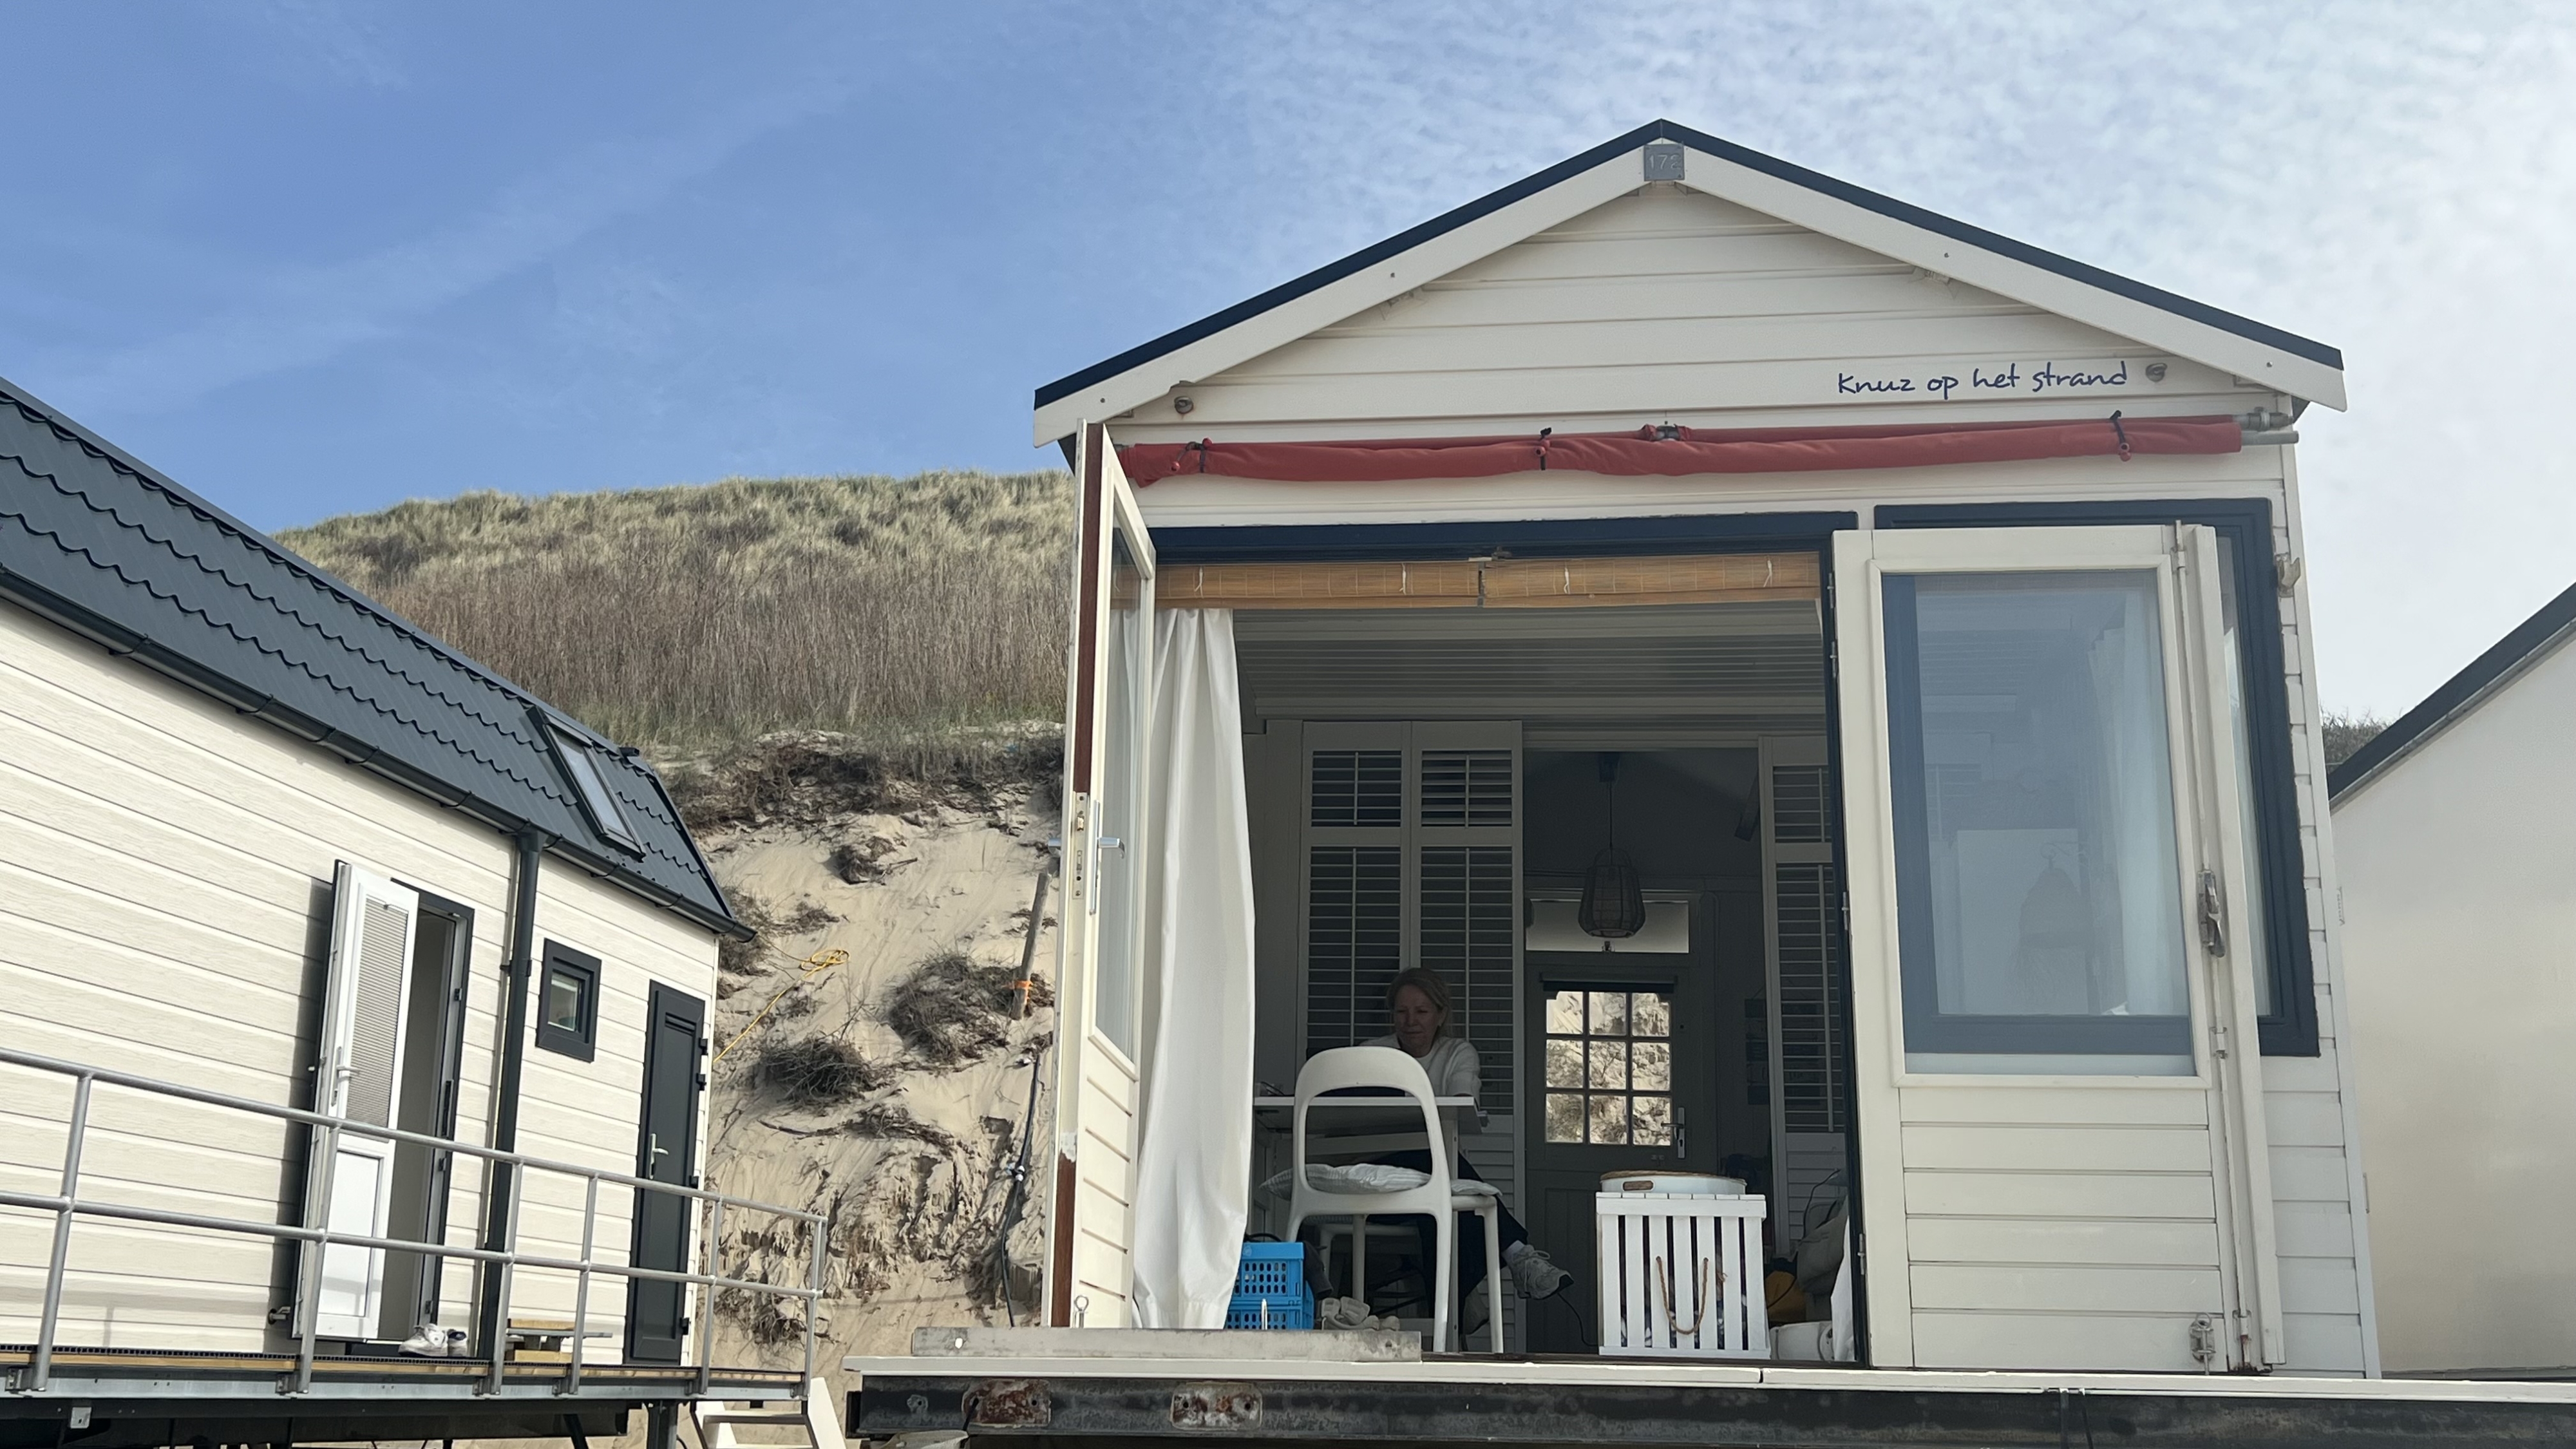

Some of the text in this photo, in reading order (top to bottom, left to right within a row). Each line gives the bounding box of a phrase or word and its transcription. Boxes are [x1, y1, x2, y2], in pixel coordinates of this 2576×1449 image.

[1648, 154, 1681, 170] 172
[1927, 375, 1959, 401] op
[1973, 363, 2020, 388] het
[2032, 361, 2127, 392] strand
